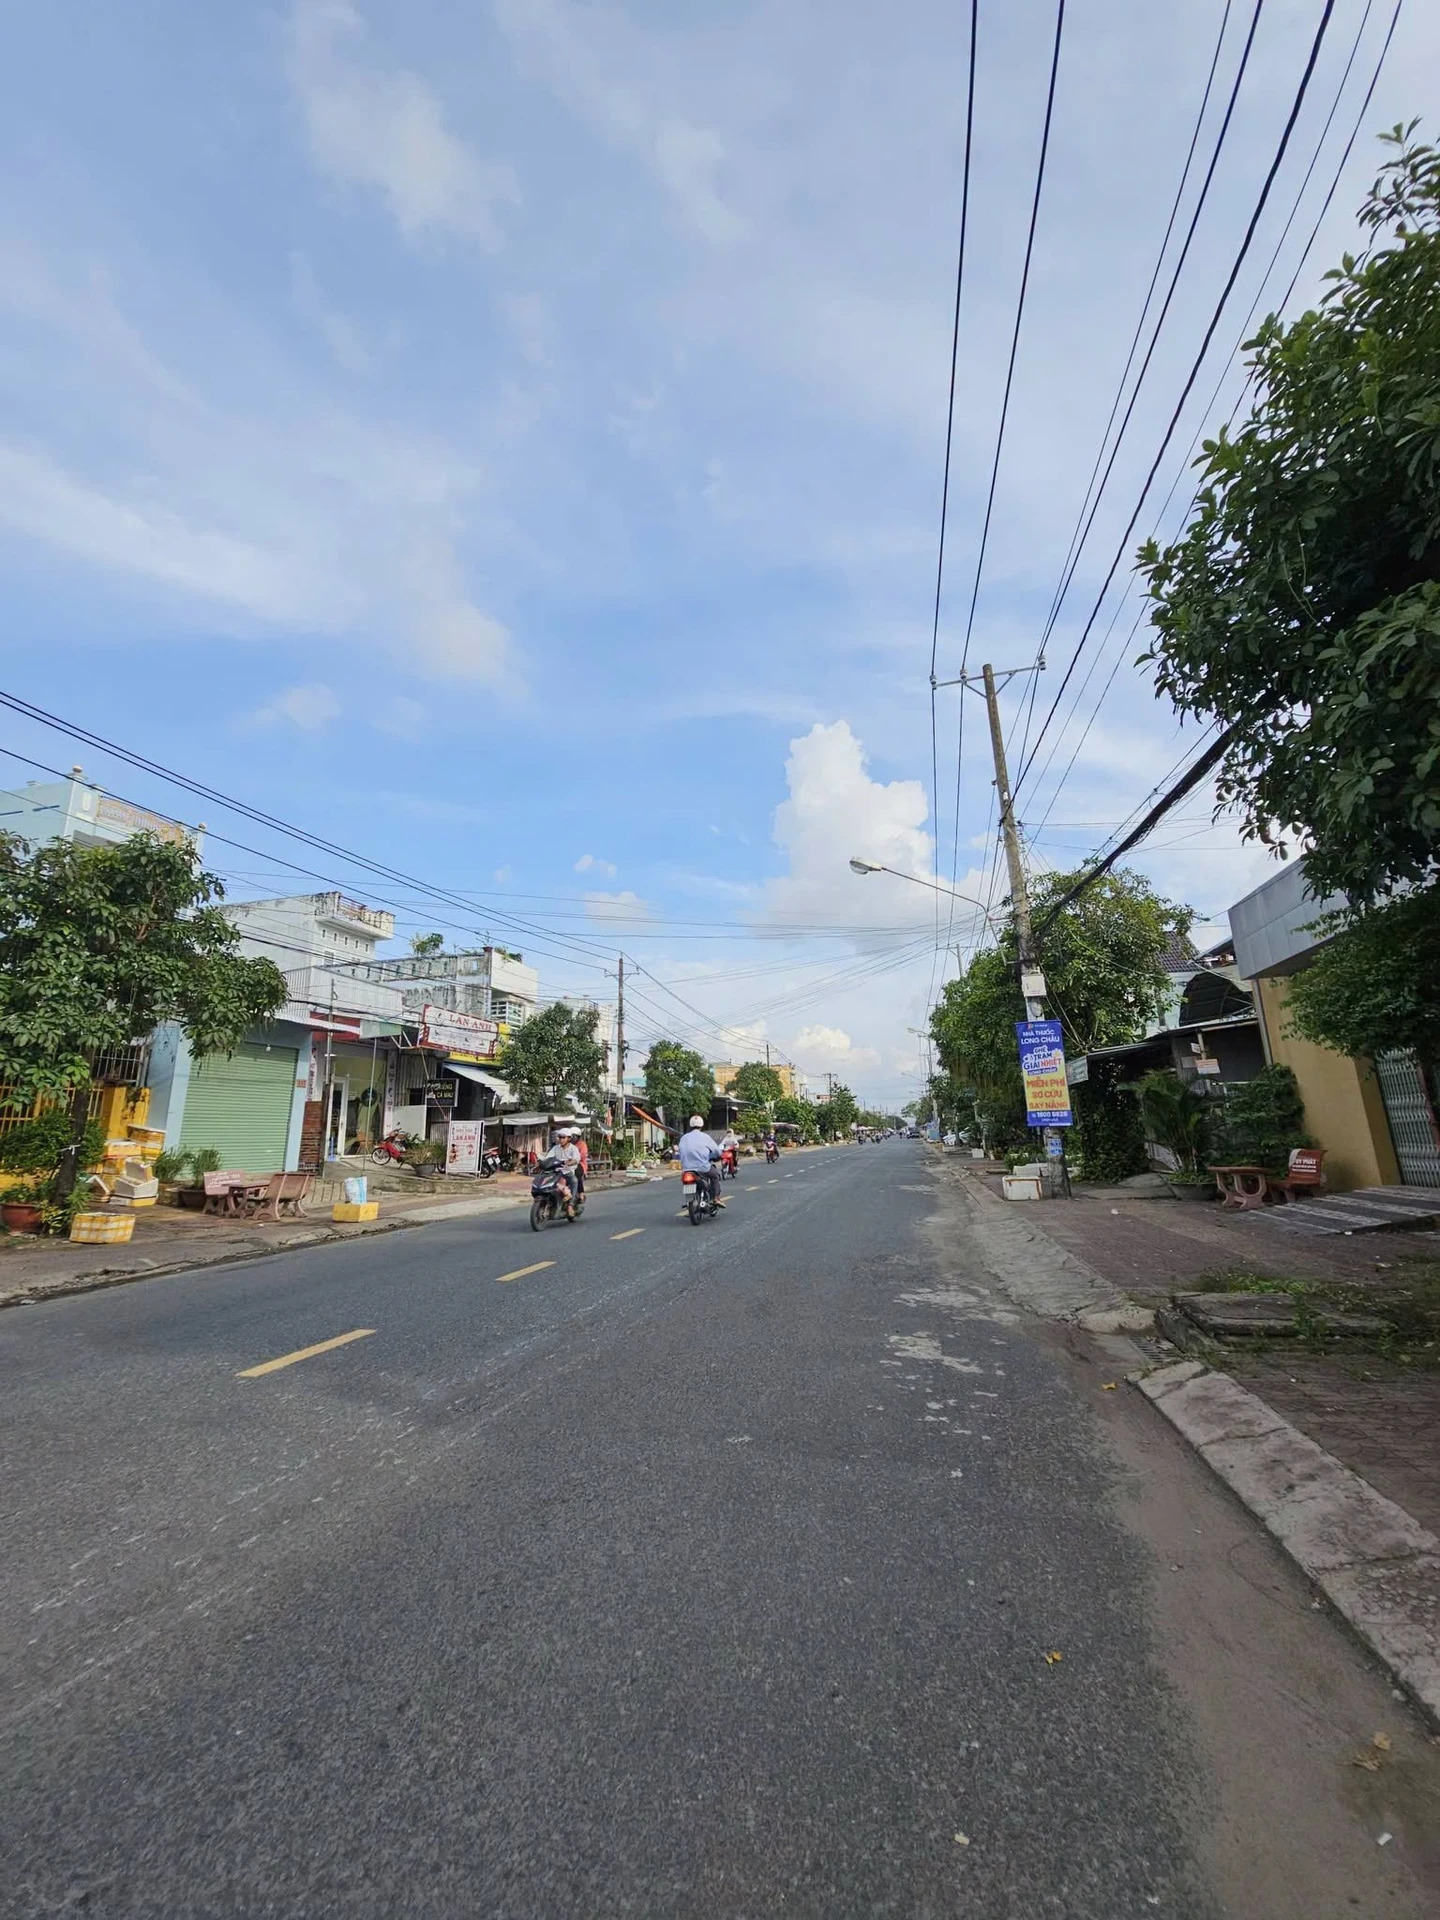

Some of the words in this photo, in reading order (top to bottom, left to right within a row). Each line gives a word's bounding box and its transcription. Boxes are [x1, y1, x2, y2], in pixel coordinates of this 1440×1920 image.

[449, 1014, 469, 1026] LAN
[472, 1020, 492, 1031] ANH
[1022, 1029, 1035, 1037] NHÀ
[1021, 1037, 1040, 1045] LONG
[1040, 1035, 1060, 1043] CHÂU
